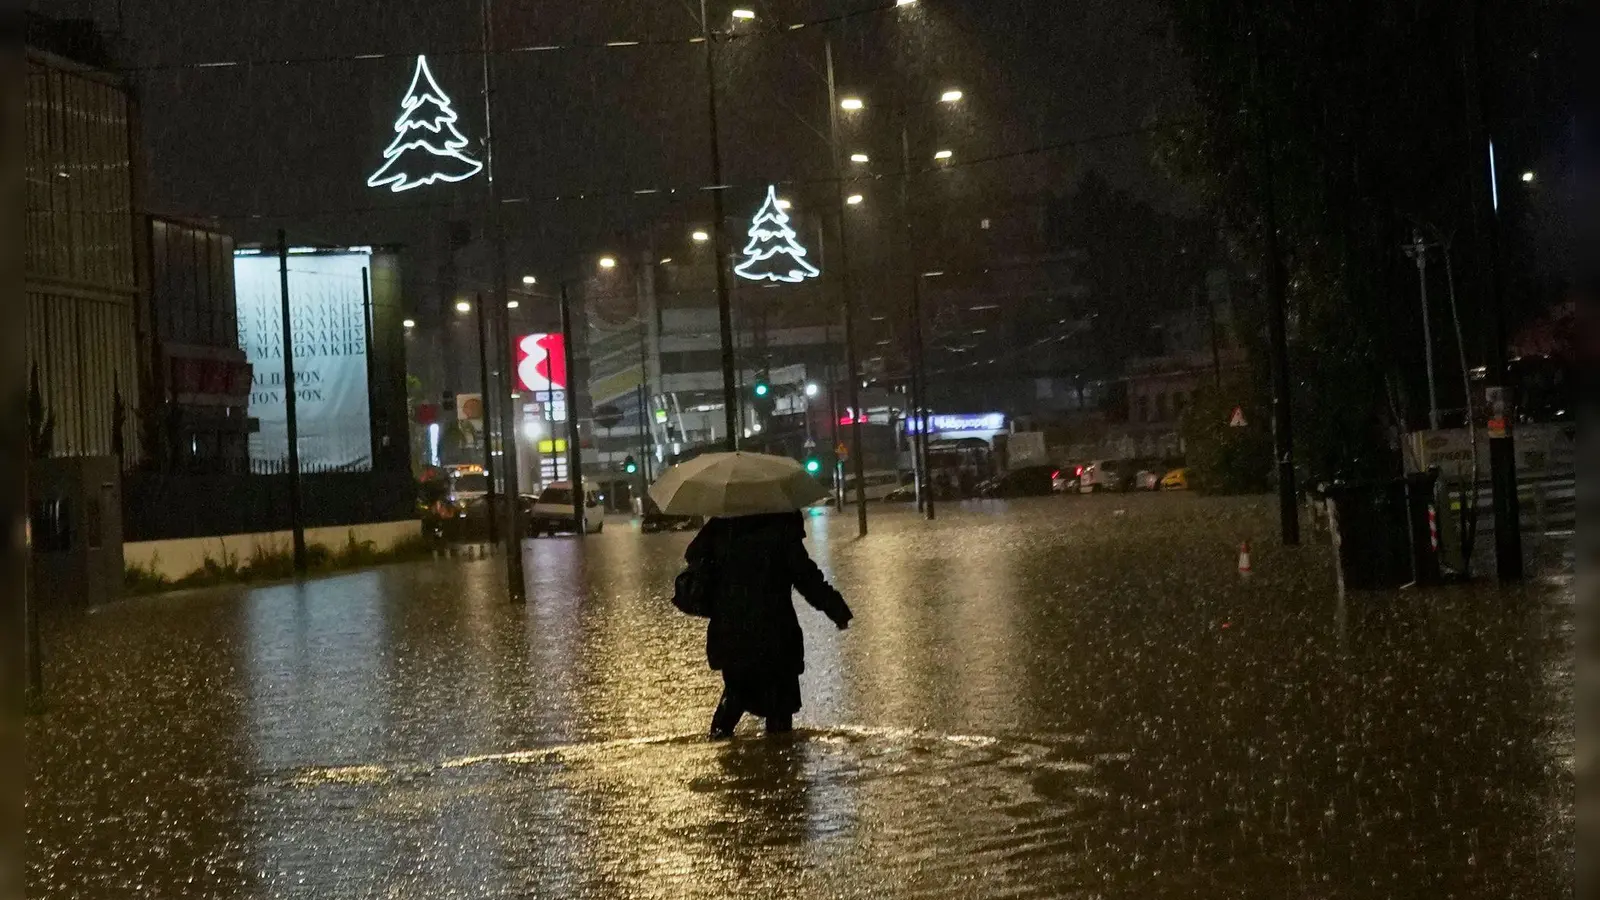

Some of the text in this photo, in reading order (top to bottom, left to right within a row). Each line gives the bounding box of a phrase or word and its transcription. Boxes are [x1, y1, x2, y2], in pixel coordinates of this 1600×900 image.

[256, 316, 363, 332] ΜΑΩΝΑΚΗΣ
[257, 328, 364, 345] ΜΑΩΝΑΚΗΣ
[257, 342, 364, 360] ΜΑΩΝΑΚΗΣ
